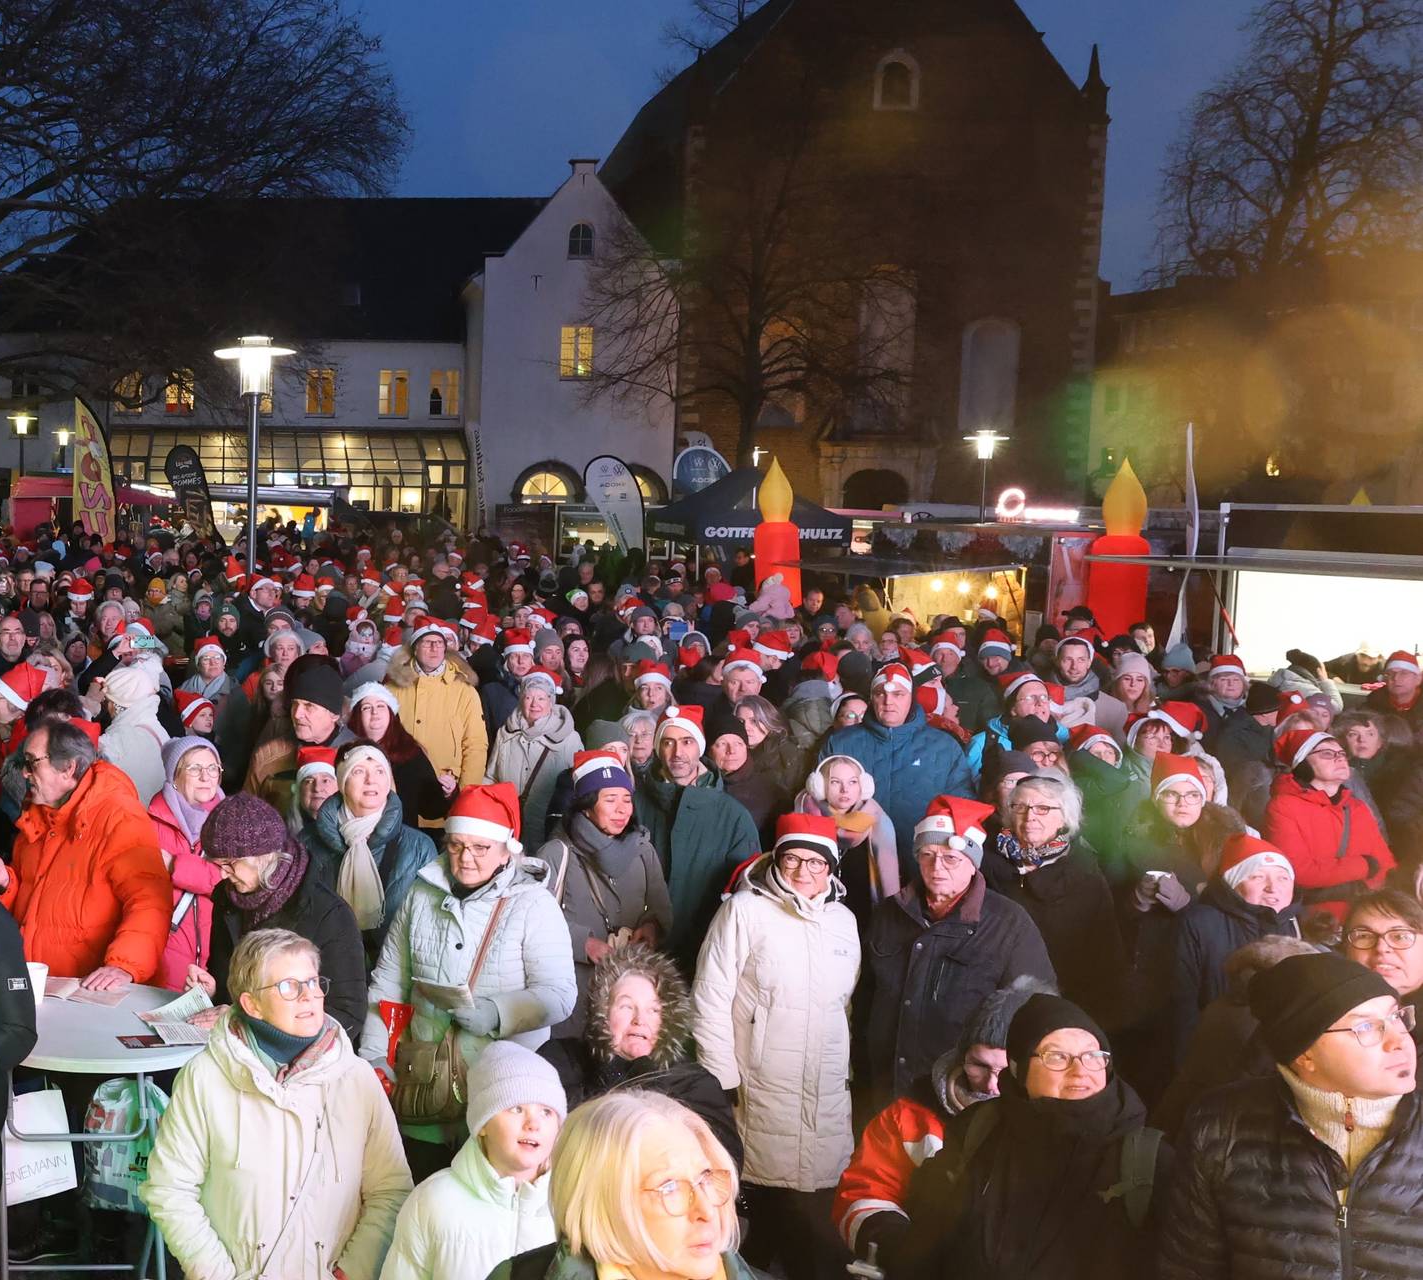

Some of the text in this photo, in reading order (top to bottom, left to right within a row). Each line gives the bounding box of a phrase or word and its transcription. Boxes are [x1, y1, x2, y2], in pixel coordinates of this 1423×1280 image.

[173, 477, 202, 486] POMMES
[704, 526, 844, 540] GOTTFR HULTZ
[5, 1154, 67, 1186] EINEMANN
